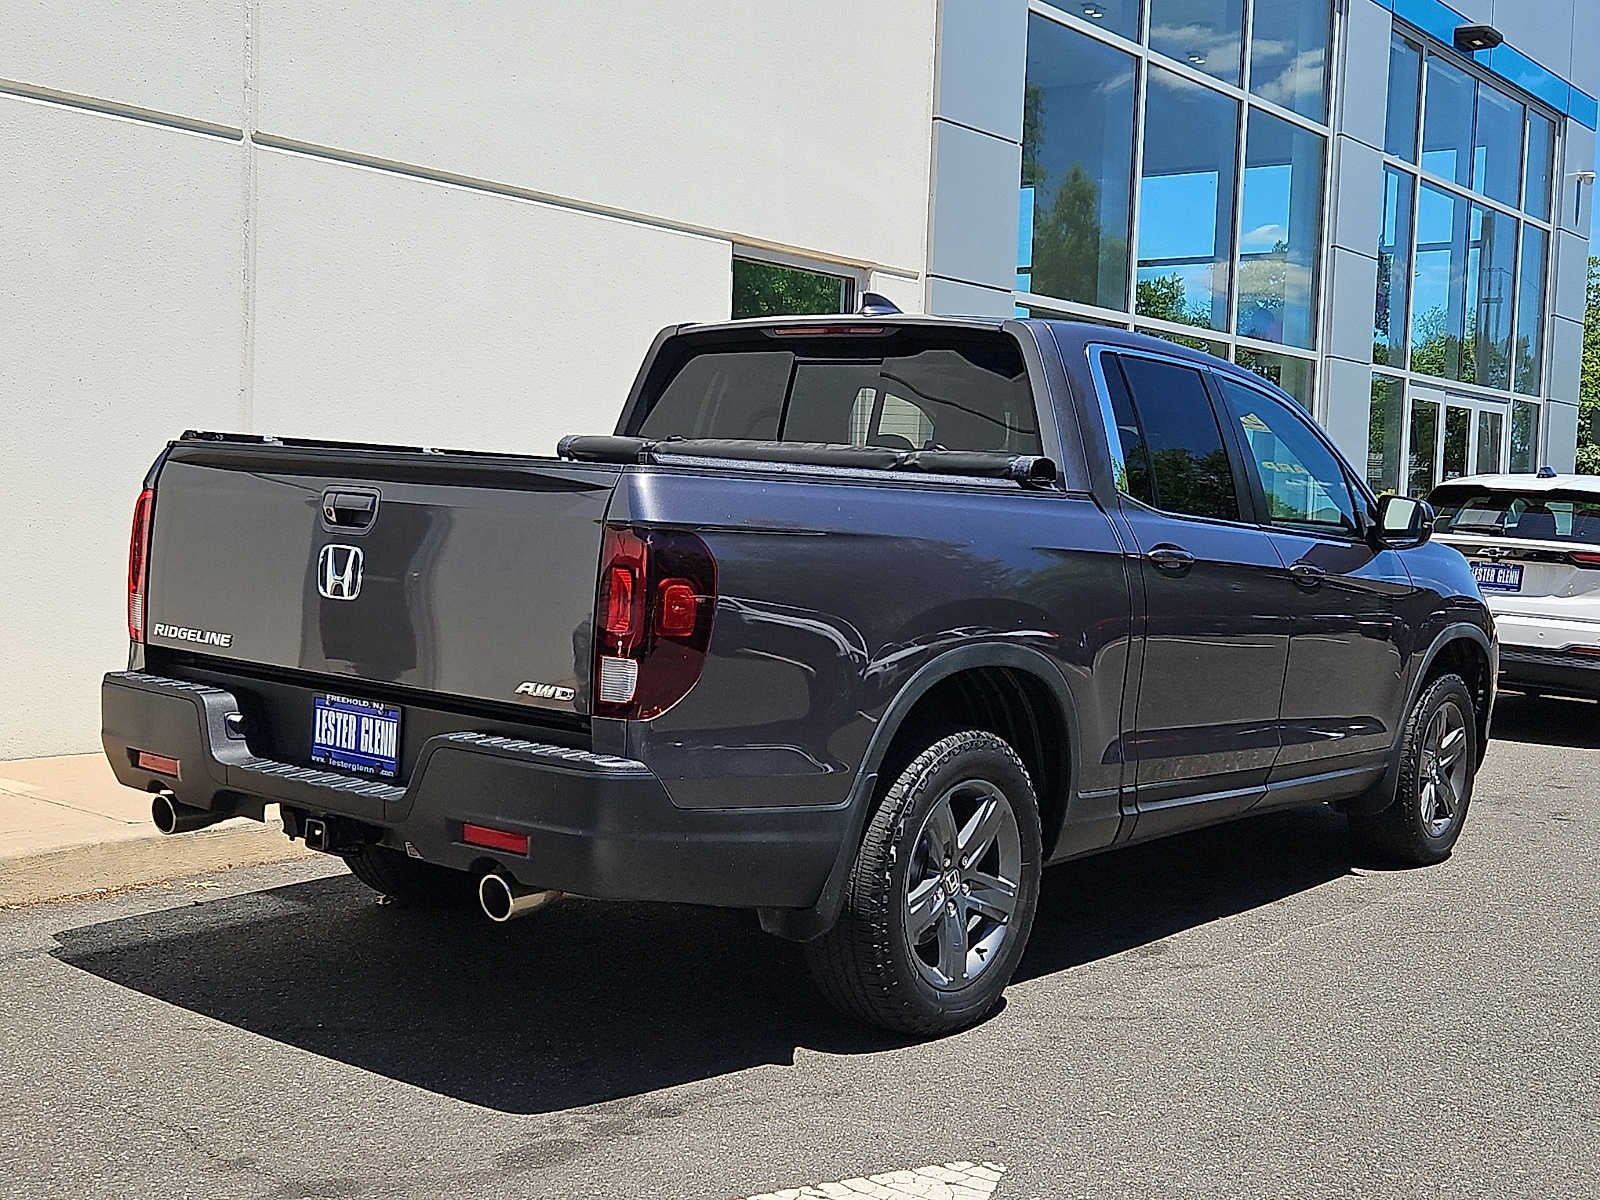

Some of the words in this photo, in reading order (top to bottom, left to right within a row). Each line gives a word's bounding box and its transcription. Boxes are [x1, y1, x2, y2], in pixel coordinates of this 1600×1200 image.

[1497, 569, 1520, 585] GLENN
[153, 623, 232, 647] RIDGELINE
[514, 681, 575, 701] AWD
[373, 702, 384, 710] NJ
[315, 708, 356, 750] LESTER
[360, 716, 397, 758] GLENN
